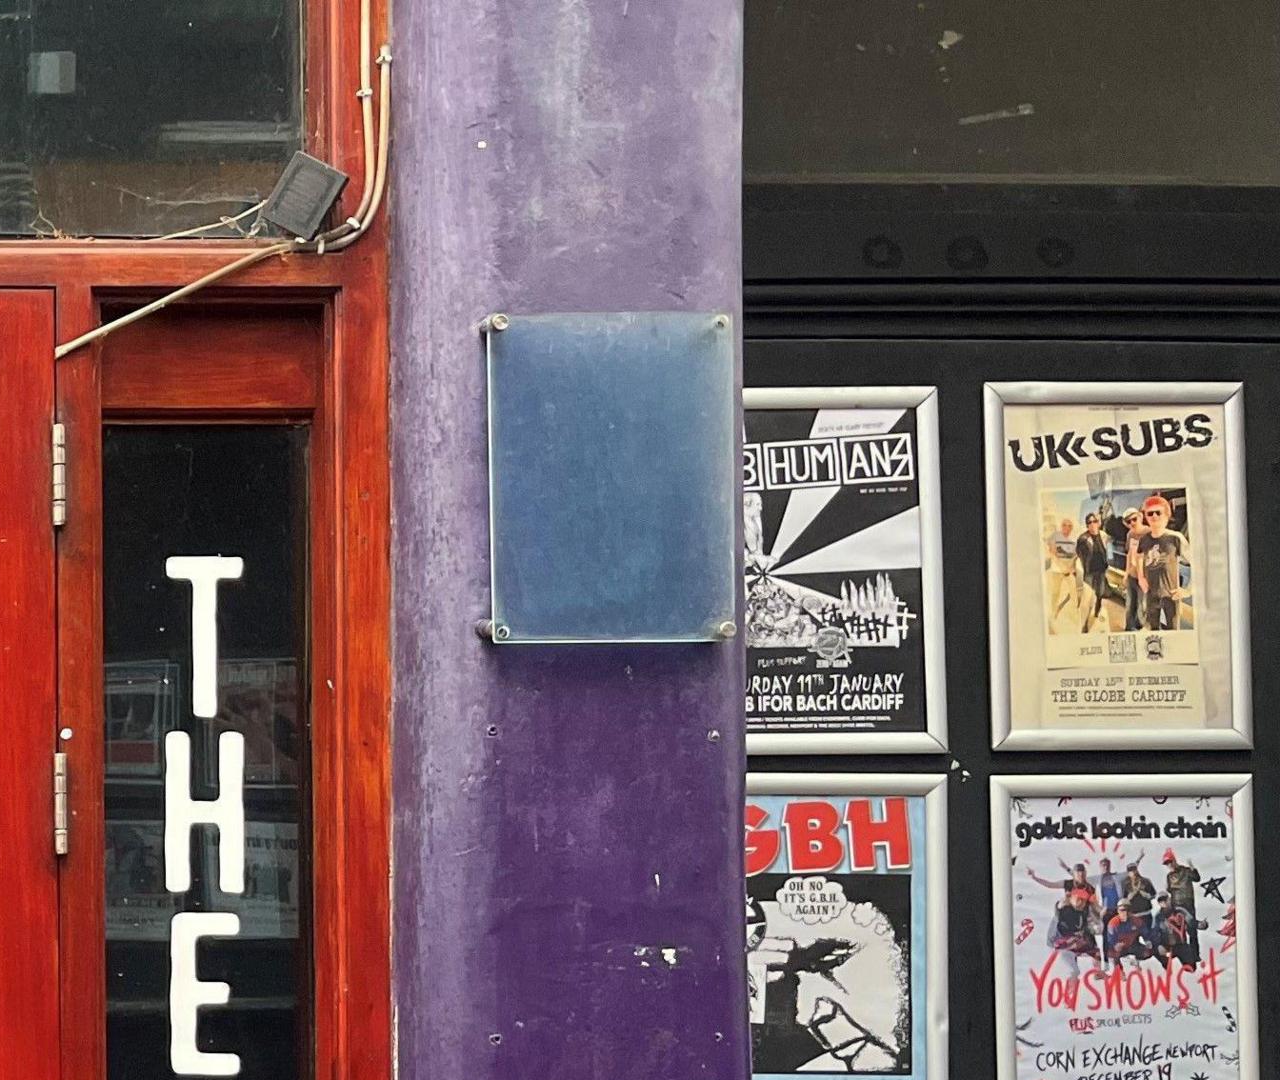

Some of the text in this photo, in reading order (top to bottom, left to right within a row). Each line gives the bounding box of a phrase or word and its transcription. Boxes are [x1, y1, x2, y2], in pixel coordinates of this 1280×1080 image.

[1092, 413, 1214, 461] SUBS
[829, 673, 904, 695] JANUARY
[1060, 677, 1100, 688] SUNDAY
[1128, 676, 1180, 686] DECEMBER
[758, 695, 793, 712] IFOR
[797, 694, 838, 712] BACH
[841, 693, 904, 711] CARDIFF
[1051, 689, 1187, 702] THE GLOBE CARDIFF
[165, 556, 244, 1076] THE
[745, 796, 912, 877] GBH
[1015, 816, 1227, 847] goldie lookin chain
[790, 881, 823, 891] OH NO
[784, 893, 806, 903] IT'S
[1036, 1034, 1219, 1073] CORN EXCHANGE NEWPORT
